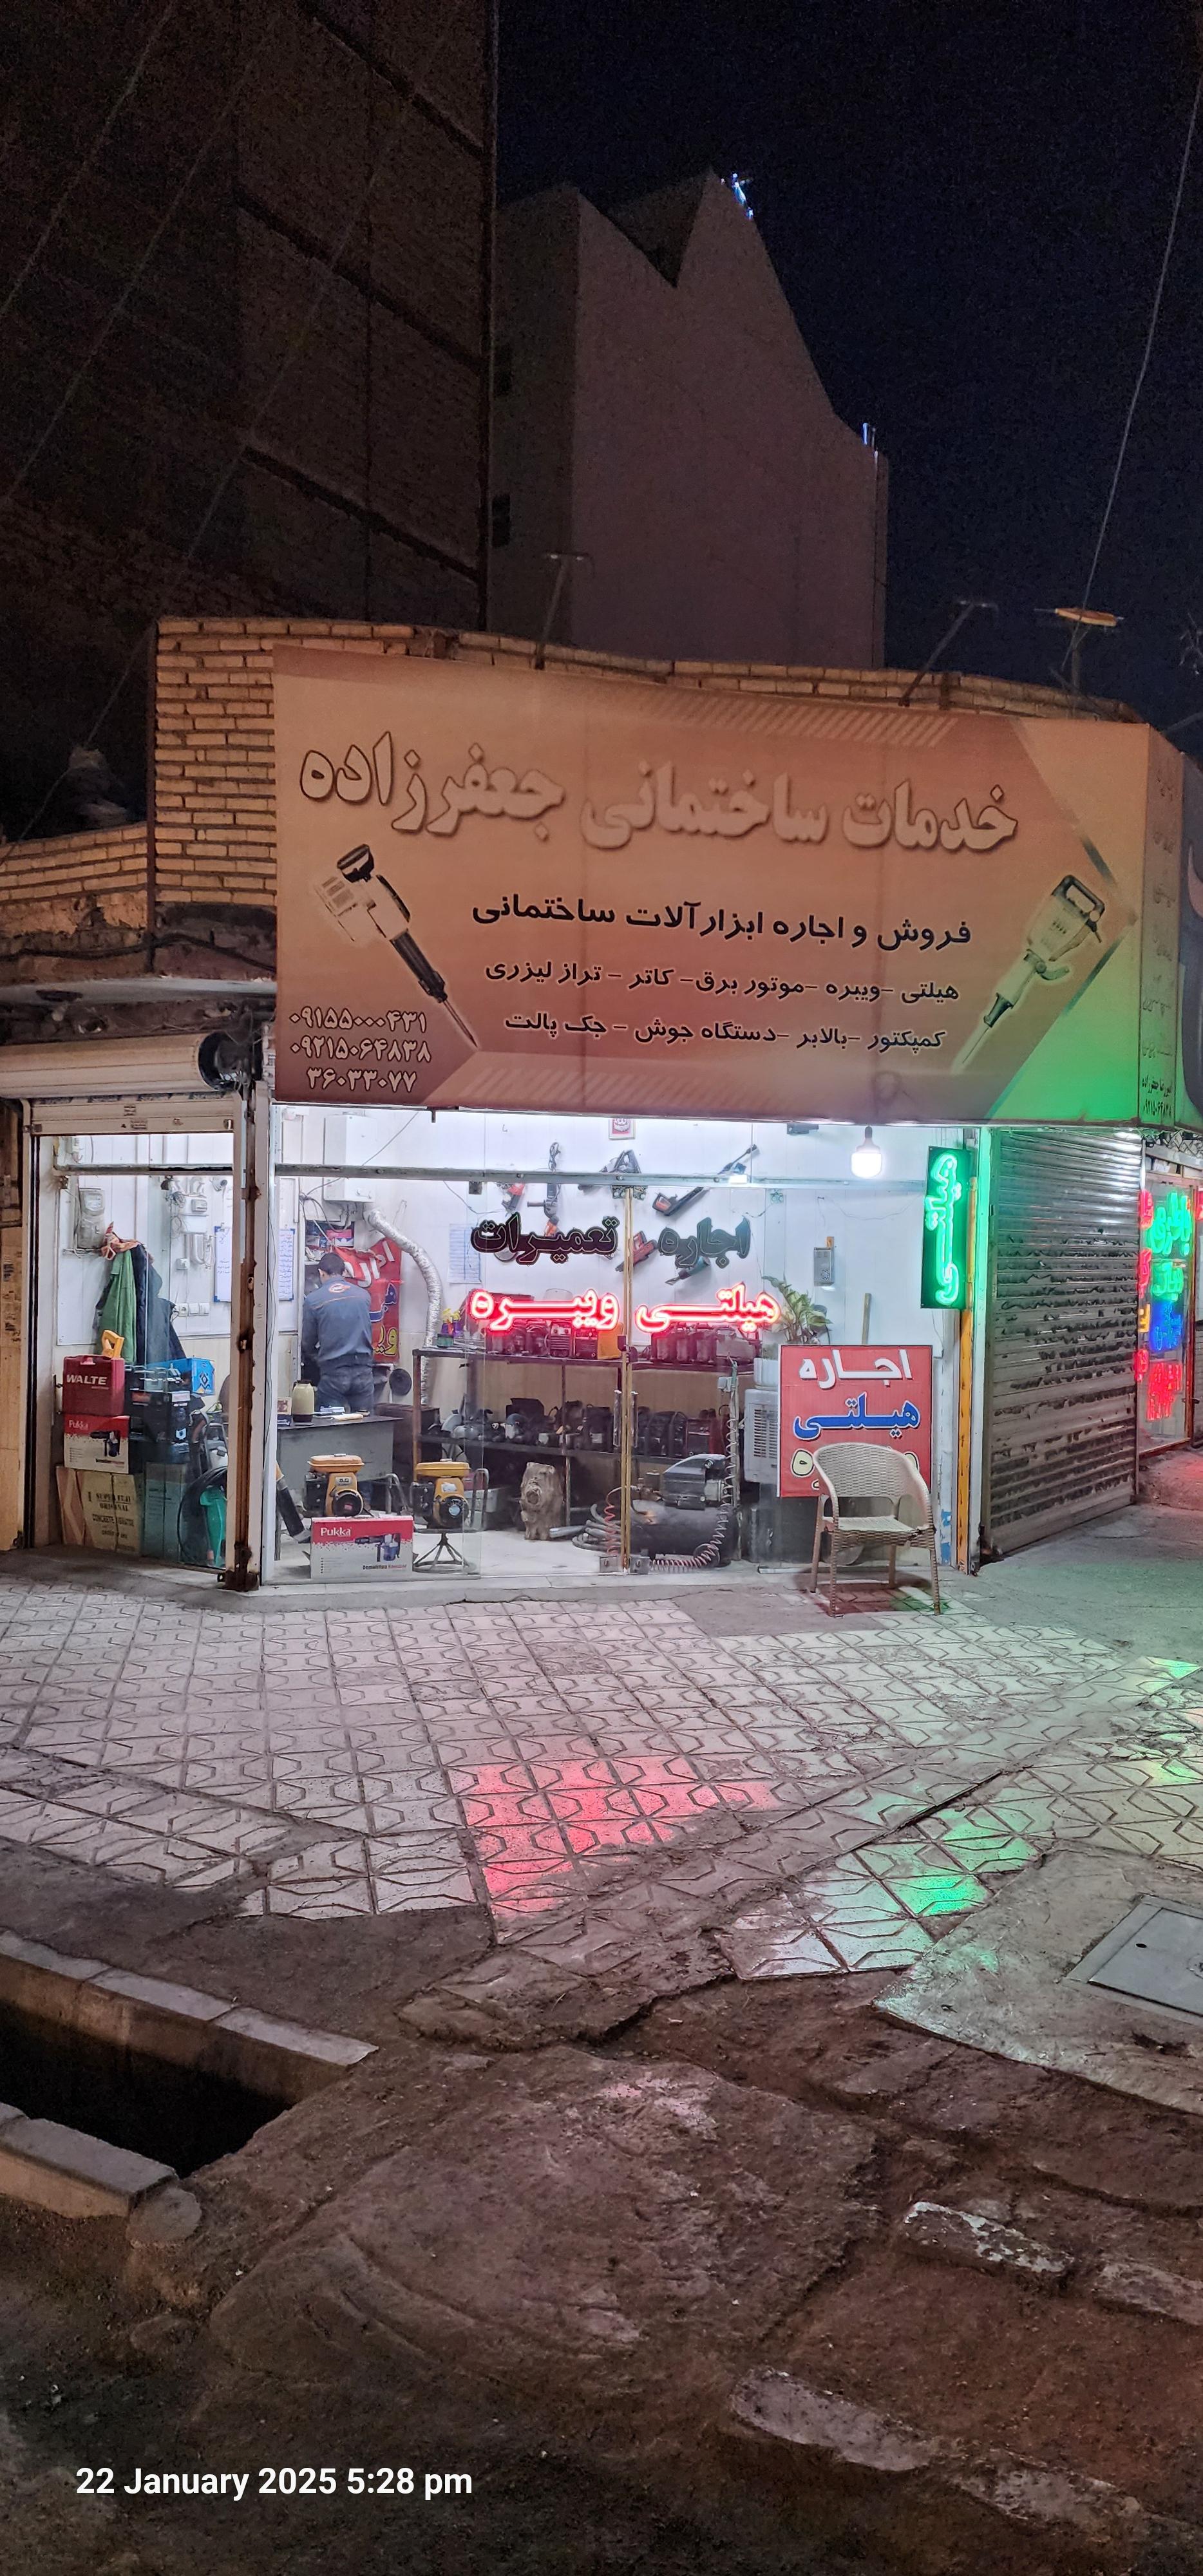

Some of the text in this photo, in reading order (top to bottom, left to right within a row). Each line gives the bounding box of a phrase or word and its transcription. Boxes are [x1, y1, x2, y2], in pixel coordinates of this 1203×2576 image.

[300, 731, 1019, 854] خدمات ساختمانی جعفرزاده
[473, 894, 615, 923] ساختمانی
[773, 914, 844, 944] اجاره
[852, 922, 867, 947] و
[877, 919, 971, 951] فروش
[486, 961, 552, 982] لیزری
[558, 962, 602, 986] تراز
[629, 968, 674, 989] کاتر
[902, 982, 959, 1004] هیلتی
[290, 1007, 427, 1033] ۰۹۱۵۵۰۰۰۴۳۱
[505, 1012, 558, 1038] پالت
[564, 1016, 607, 1038] جک
[634, 1019, 694, 1044] جوش
[867, 1031, 947, 1054] کمپکتور
[307, 1066, 417, 1093] ۳۶۰۳۳۰۷۷
[471, 1213, 620, 1265] تعمیرات
[658, 1217, 751, 1268] اجاره
[469, 1282, 781, 1332] هیلتی ویبره
[799, 1349, 913, 1389] اجاره
[793, 1391, 920, 1441] هیلتی
[320, 1527, 351, 1537] Pukka
